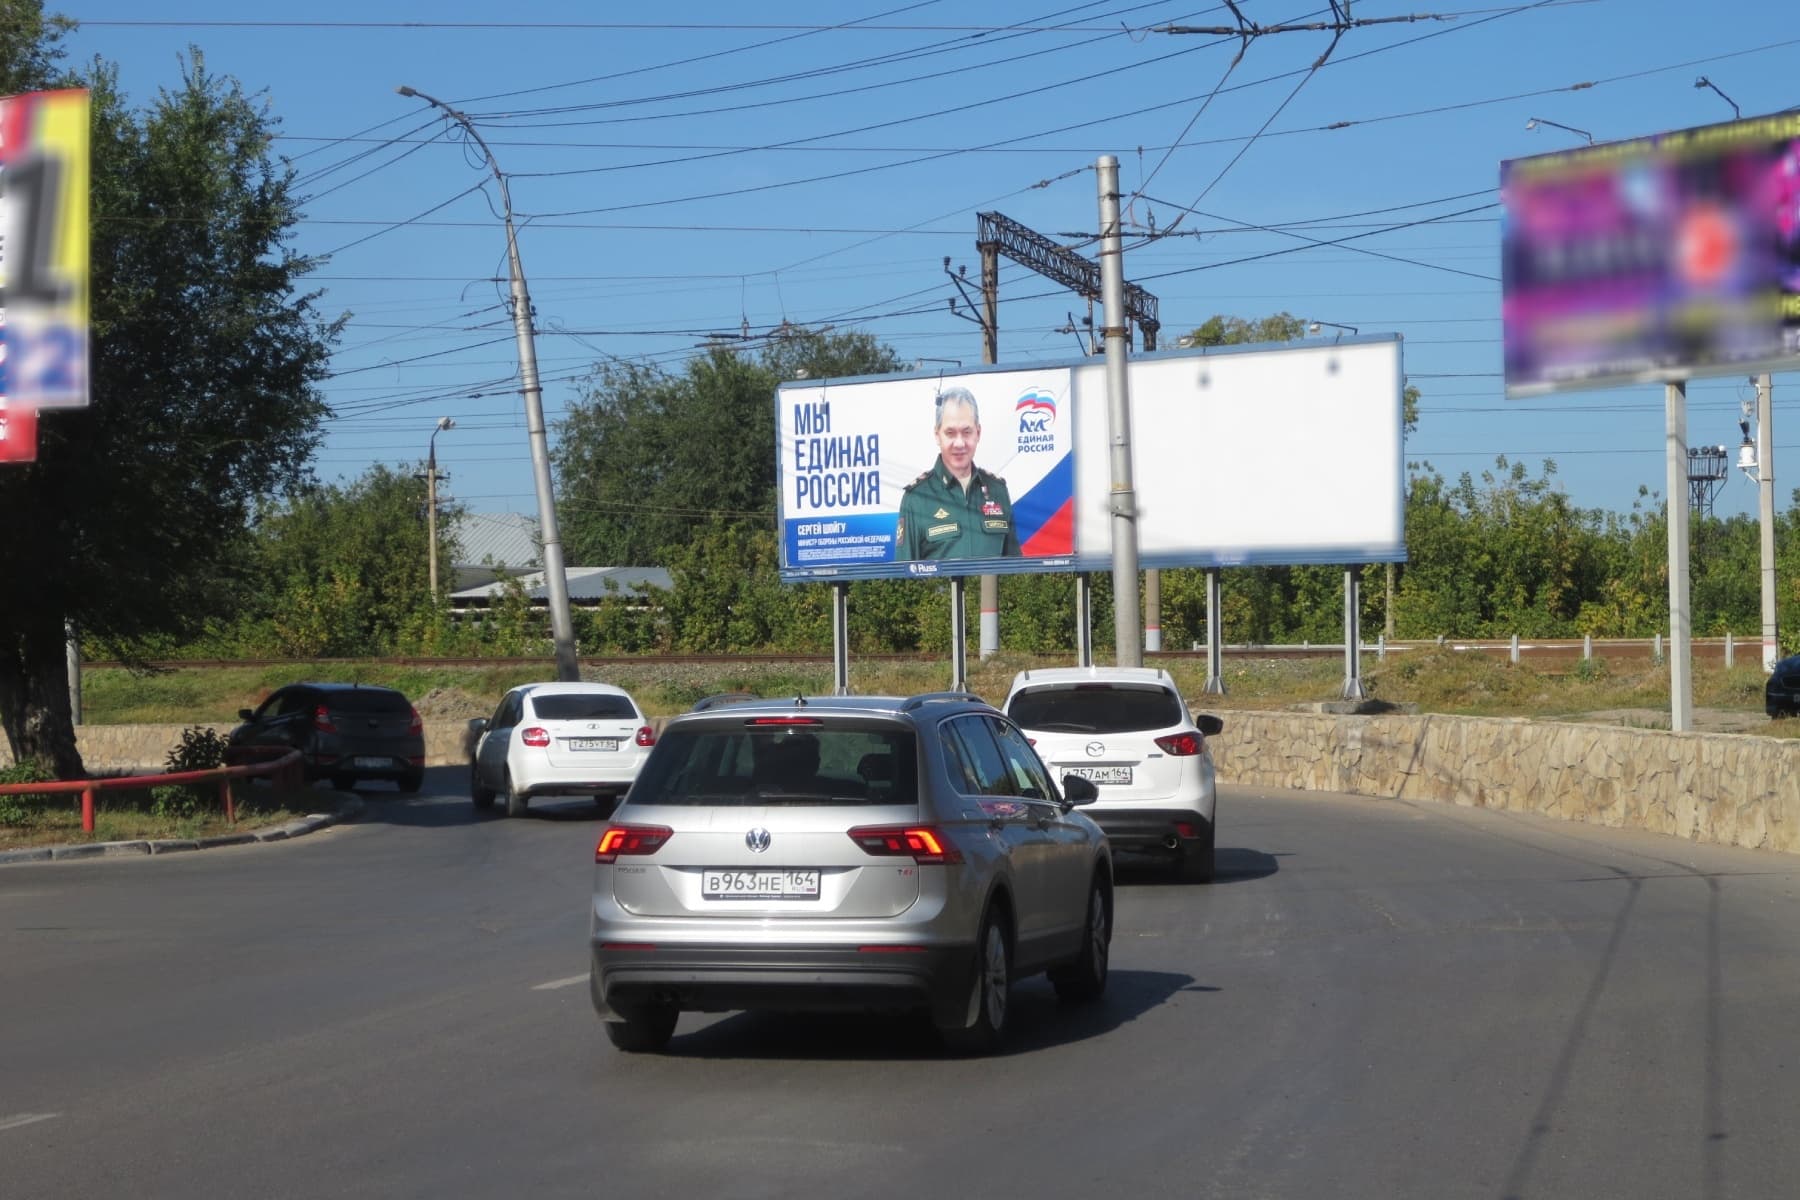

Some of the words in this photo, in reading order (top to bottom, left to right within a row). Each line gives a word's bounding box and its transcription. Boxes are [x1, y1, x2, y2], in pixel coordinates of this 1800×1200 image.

[794, 401, 831, 436] МЫ
[1017, 434, 1055, 445] ЕДИНАЯ
[795, 433, 880, 475] ЕДИНАЯ
[1017, 444, 1055, 454] РОССИЯ
[796, 470, 881, 510] РОССИЯ
[797, 522, 822, 535] СЕРГЕЙ
[1112, 767, 1129, 777] 164
[710, 872, 782, 891] В963НЕ
[786, 871, 815, 886] 164
